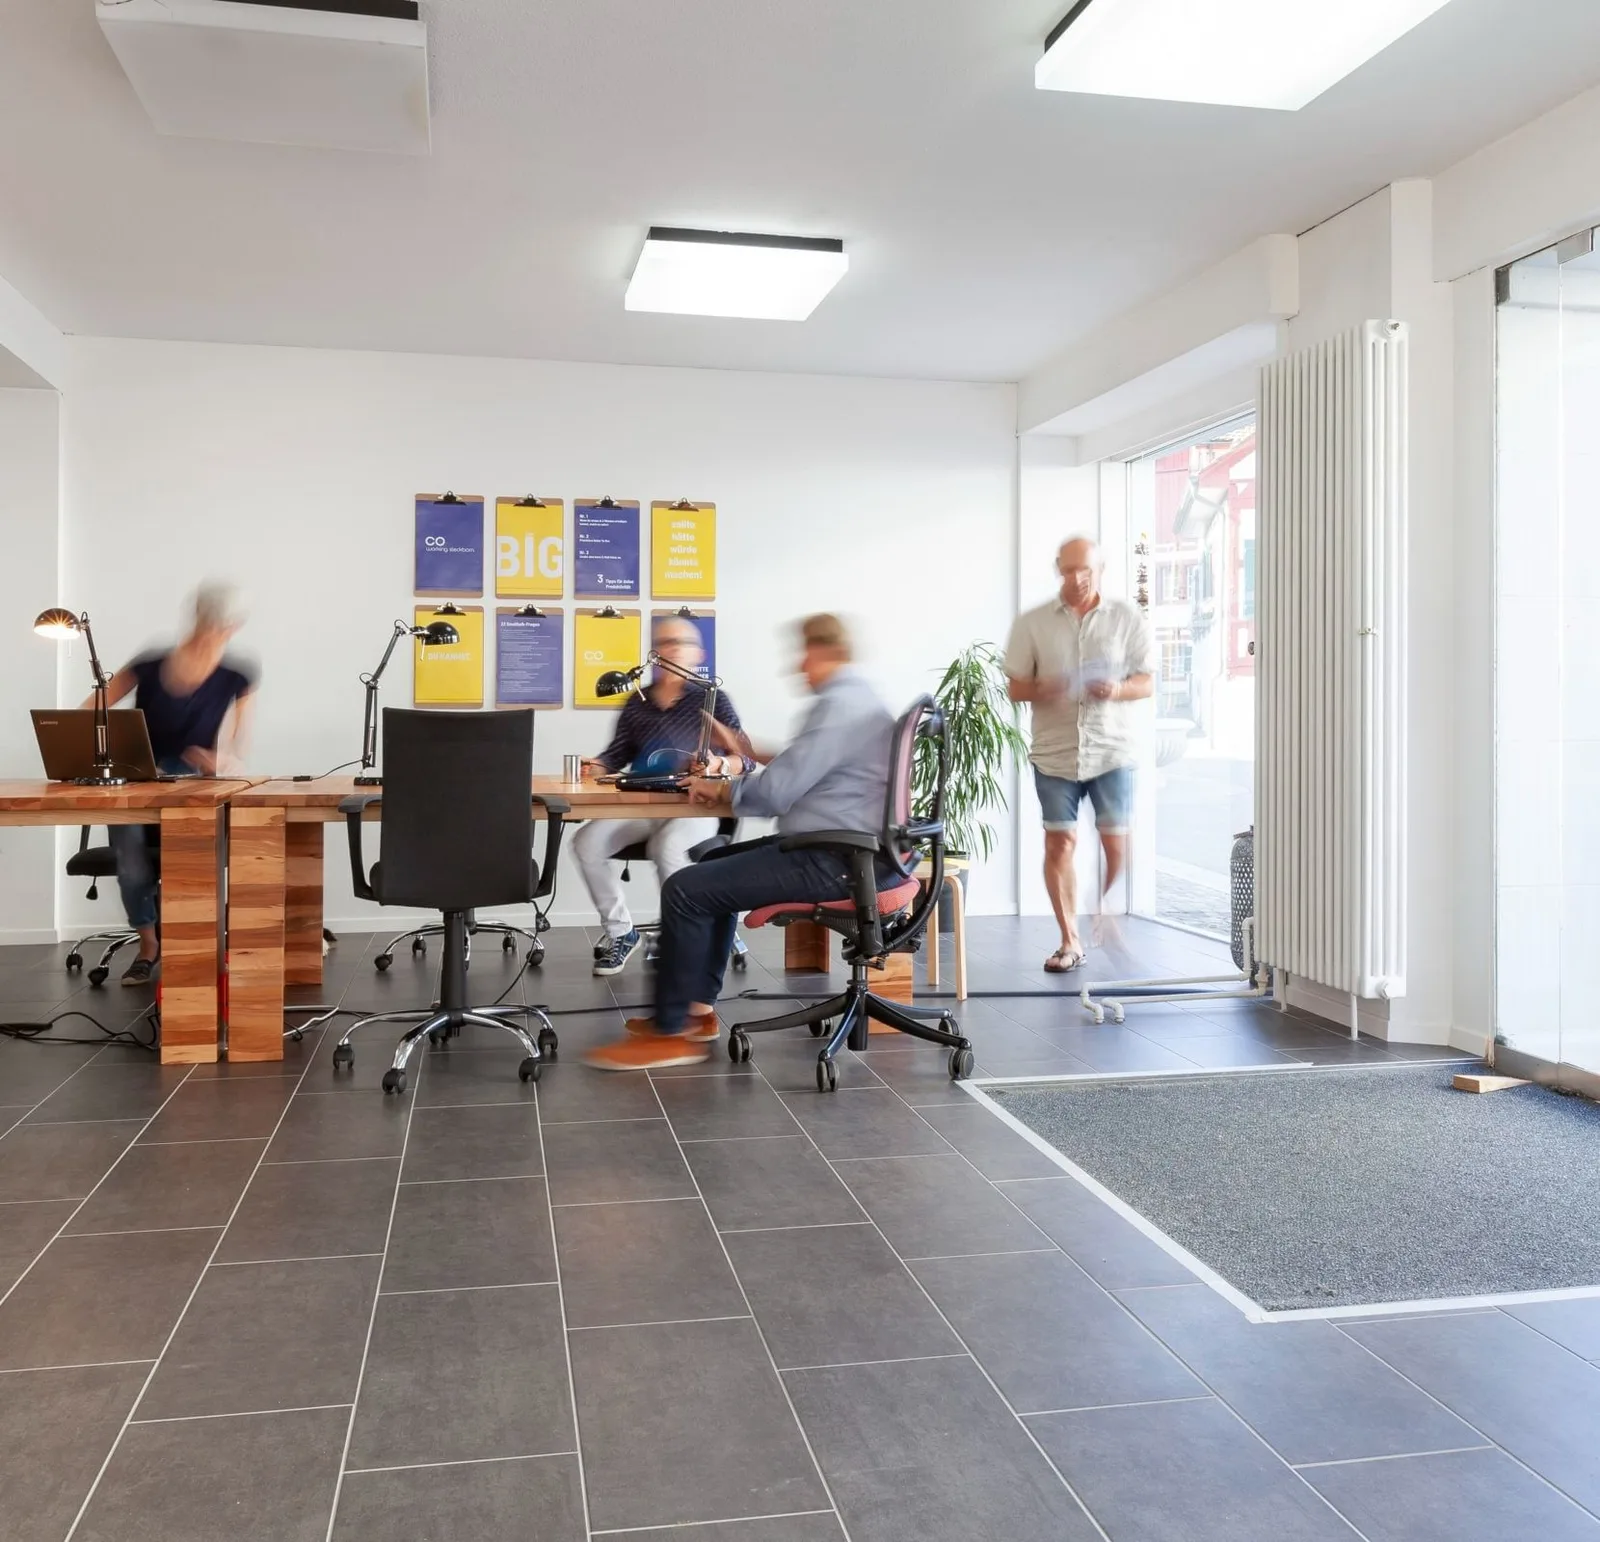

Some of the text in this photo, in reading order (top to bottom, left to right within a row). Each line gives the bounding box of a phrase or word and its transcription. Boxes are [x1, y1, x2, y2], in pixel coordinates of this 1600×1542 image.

[672, 532, 696, 542] hätte
[670, 546, 697, 554] würde
[597, 574, 604, 583] 3
[664, 570, 702, 580] machen!
